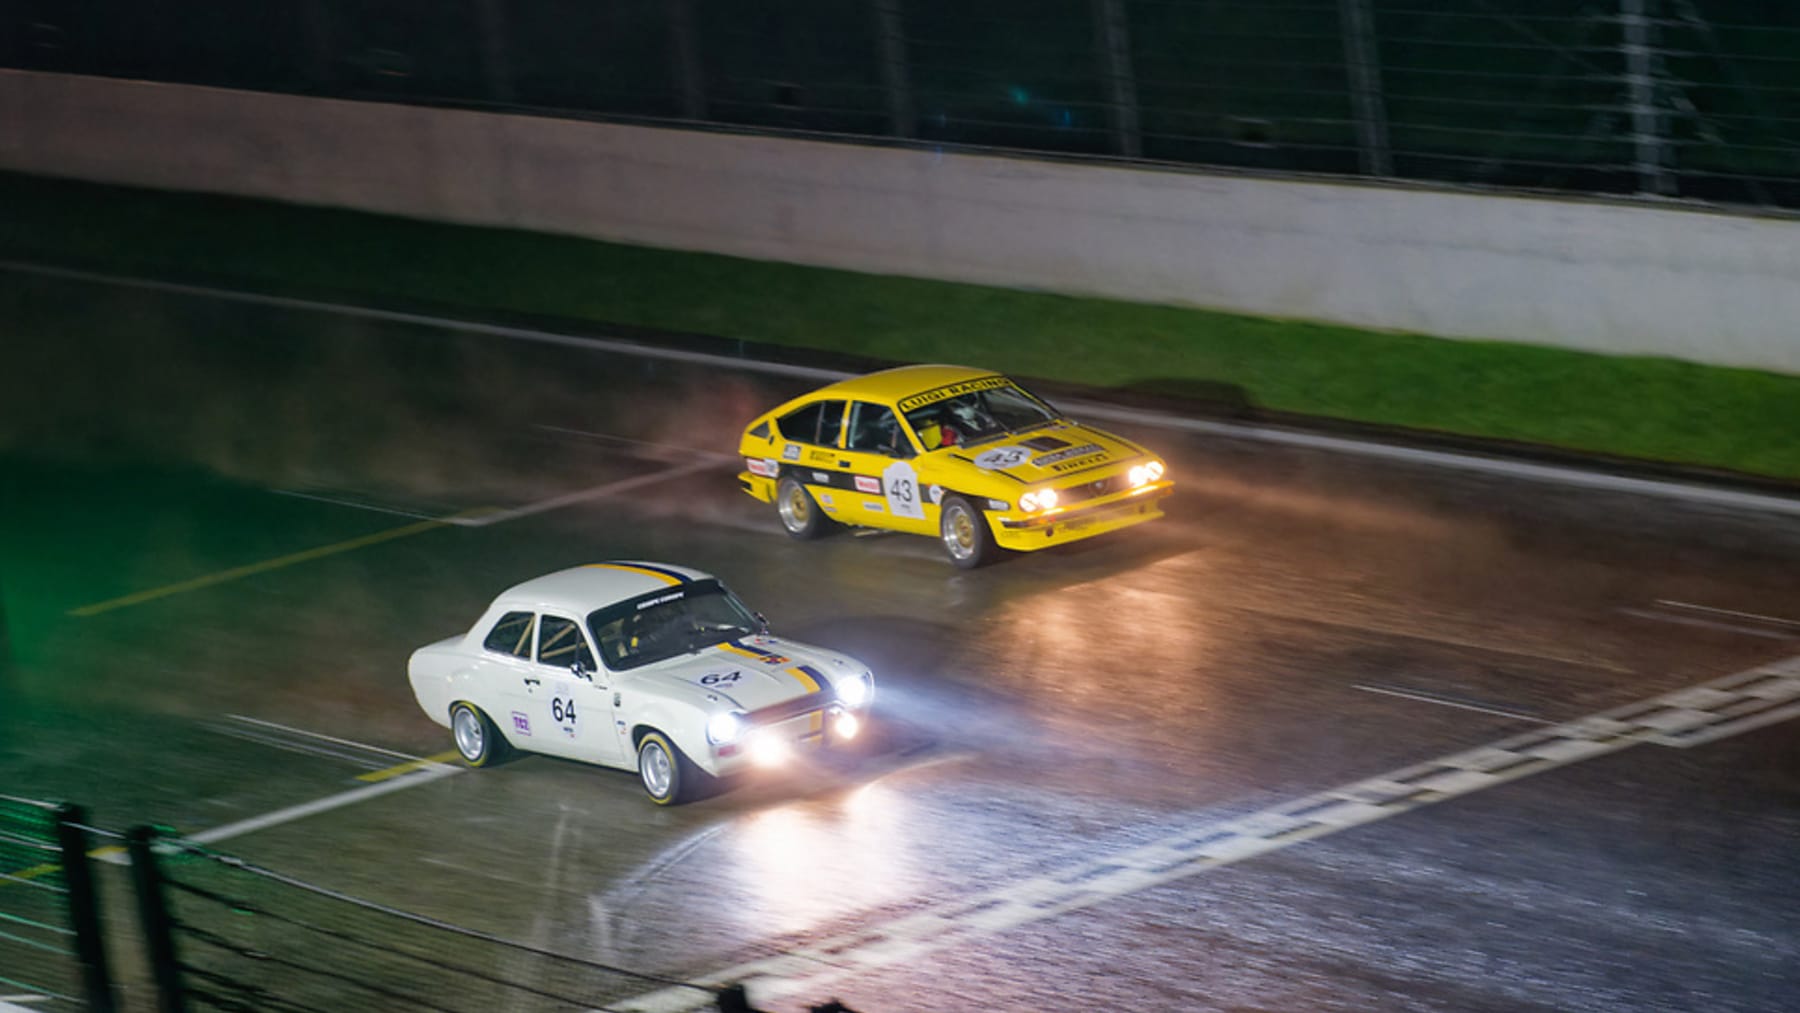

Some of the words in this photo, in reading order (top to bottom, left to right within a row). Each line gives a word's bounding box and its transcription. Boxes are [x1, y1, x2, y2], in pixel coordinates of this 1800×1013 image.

[901, 390, 947, 409] LUIGI
[948, 377, 1010, 397] RACING
[983, 449, 1024, 463] 43
[1051, 453, 1109, 471] PIRELLI
[890, 478, 913, 502] 43
[700, 671, 742, 684] 64
[552, 697, 576, 724] 64
